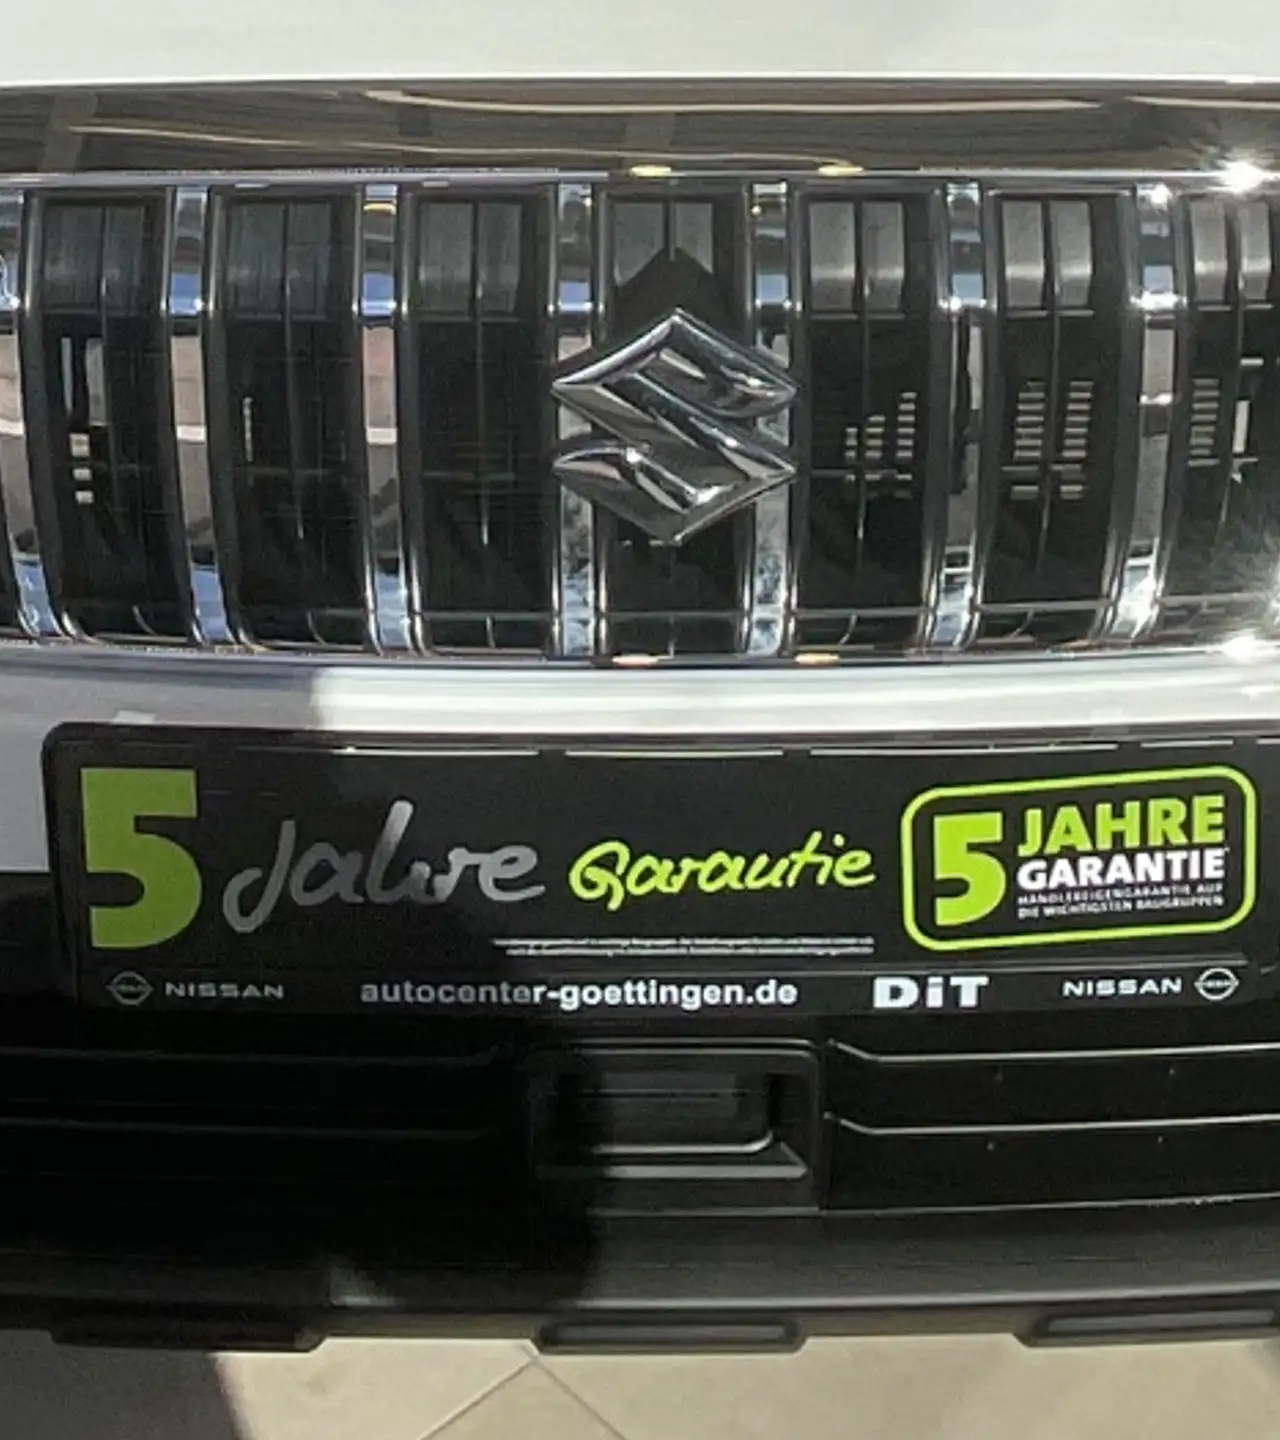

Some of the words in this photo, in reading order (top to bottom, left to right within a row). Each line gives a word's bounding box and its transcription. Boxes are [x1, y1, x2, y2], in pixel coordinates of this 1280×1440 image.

[1017, 795, 1225, 857] JAHRE
[81, 768, 202, 948] 5
[933, 812, 1007, 926] 5
[1017, 906, 1039, 920] DIE
[164, 981, 285, 1000] NISSAN
[360, 979, 798, 1011] autocenter-goettingen.de
[1062, 977, 1183, 997] NISSAN
